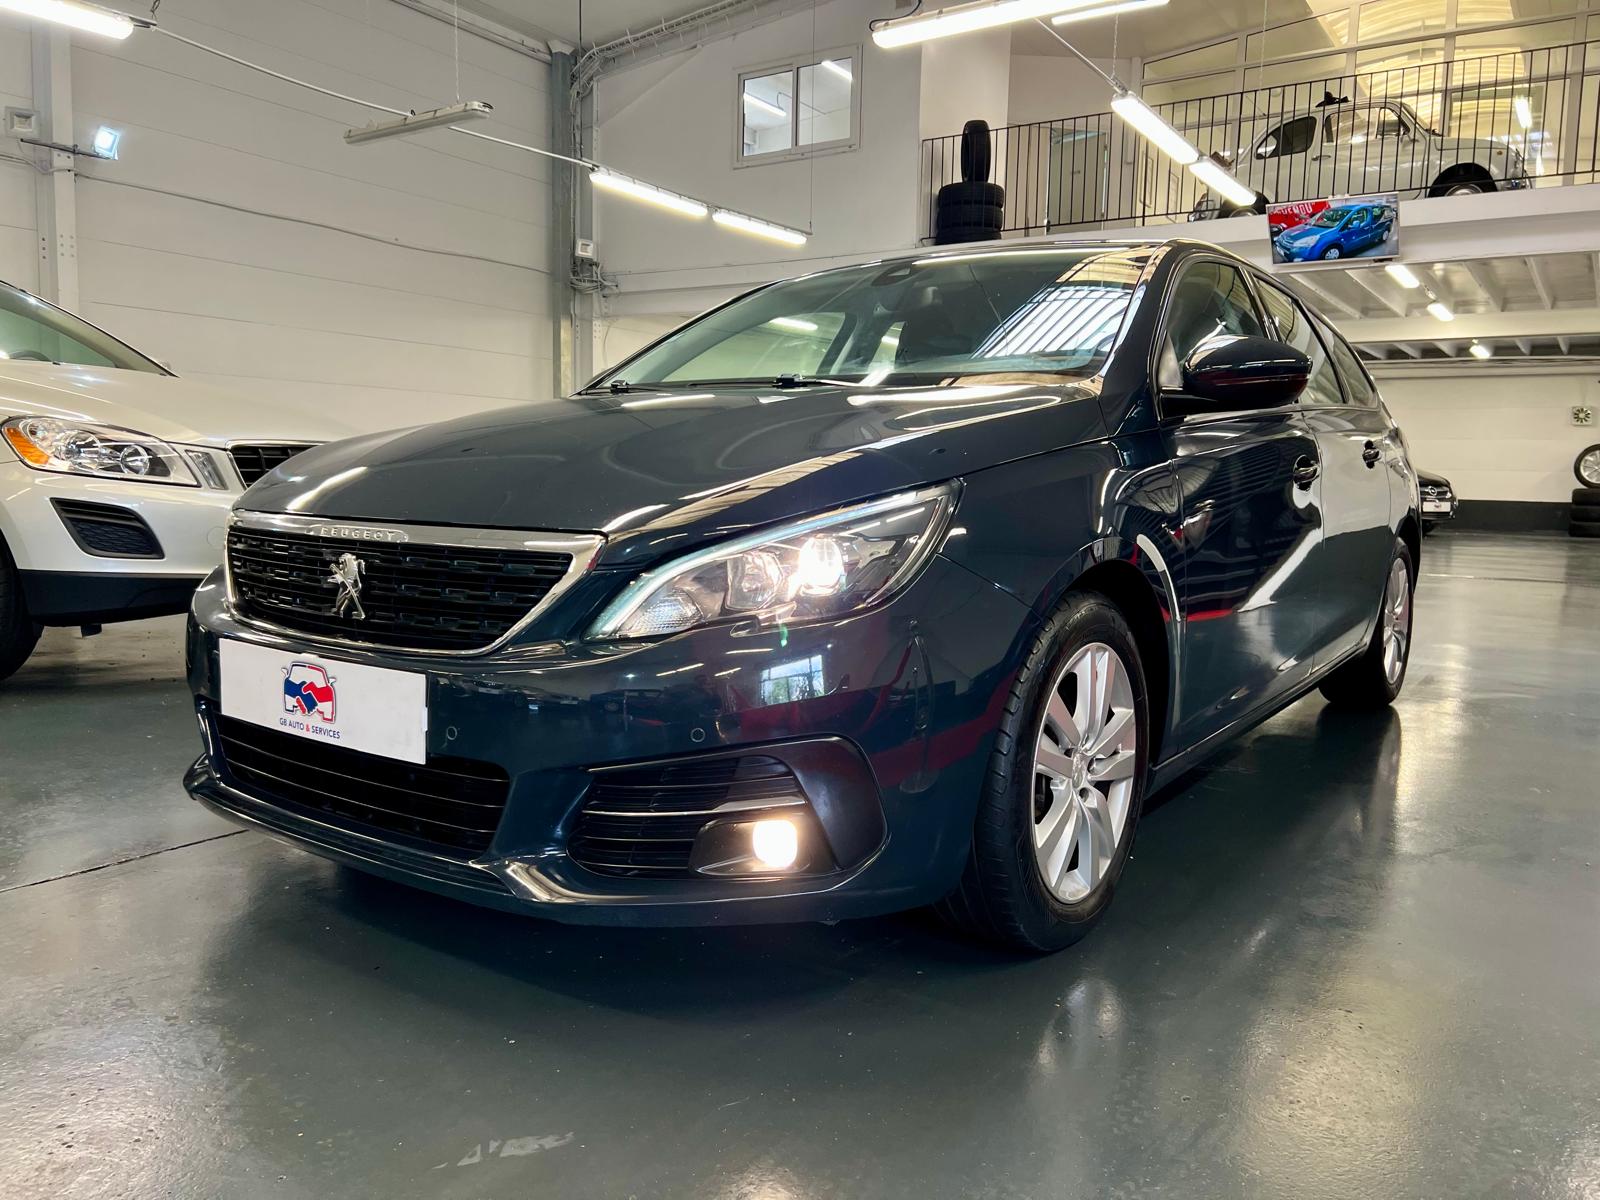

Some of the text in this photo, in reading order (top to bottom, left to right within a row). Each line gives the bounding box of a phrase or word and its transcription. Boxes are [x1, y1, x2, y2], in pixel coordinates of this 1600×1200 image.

[320, 527, 395, 541] PEUGEOT
[280, 718, 340, 739] GB AUTO & SERVICES
